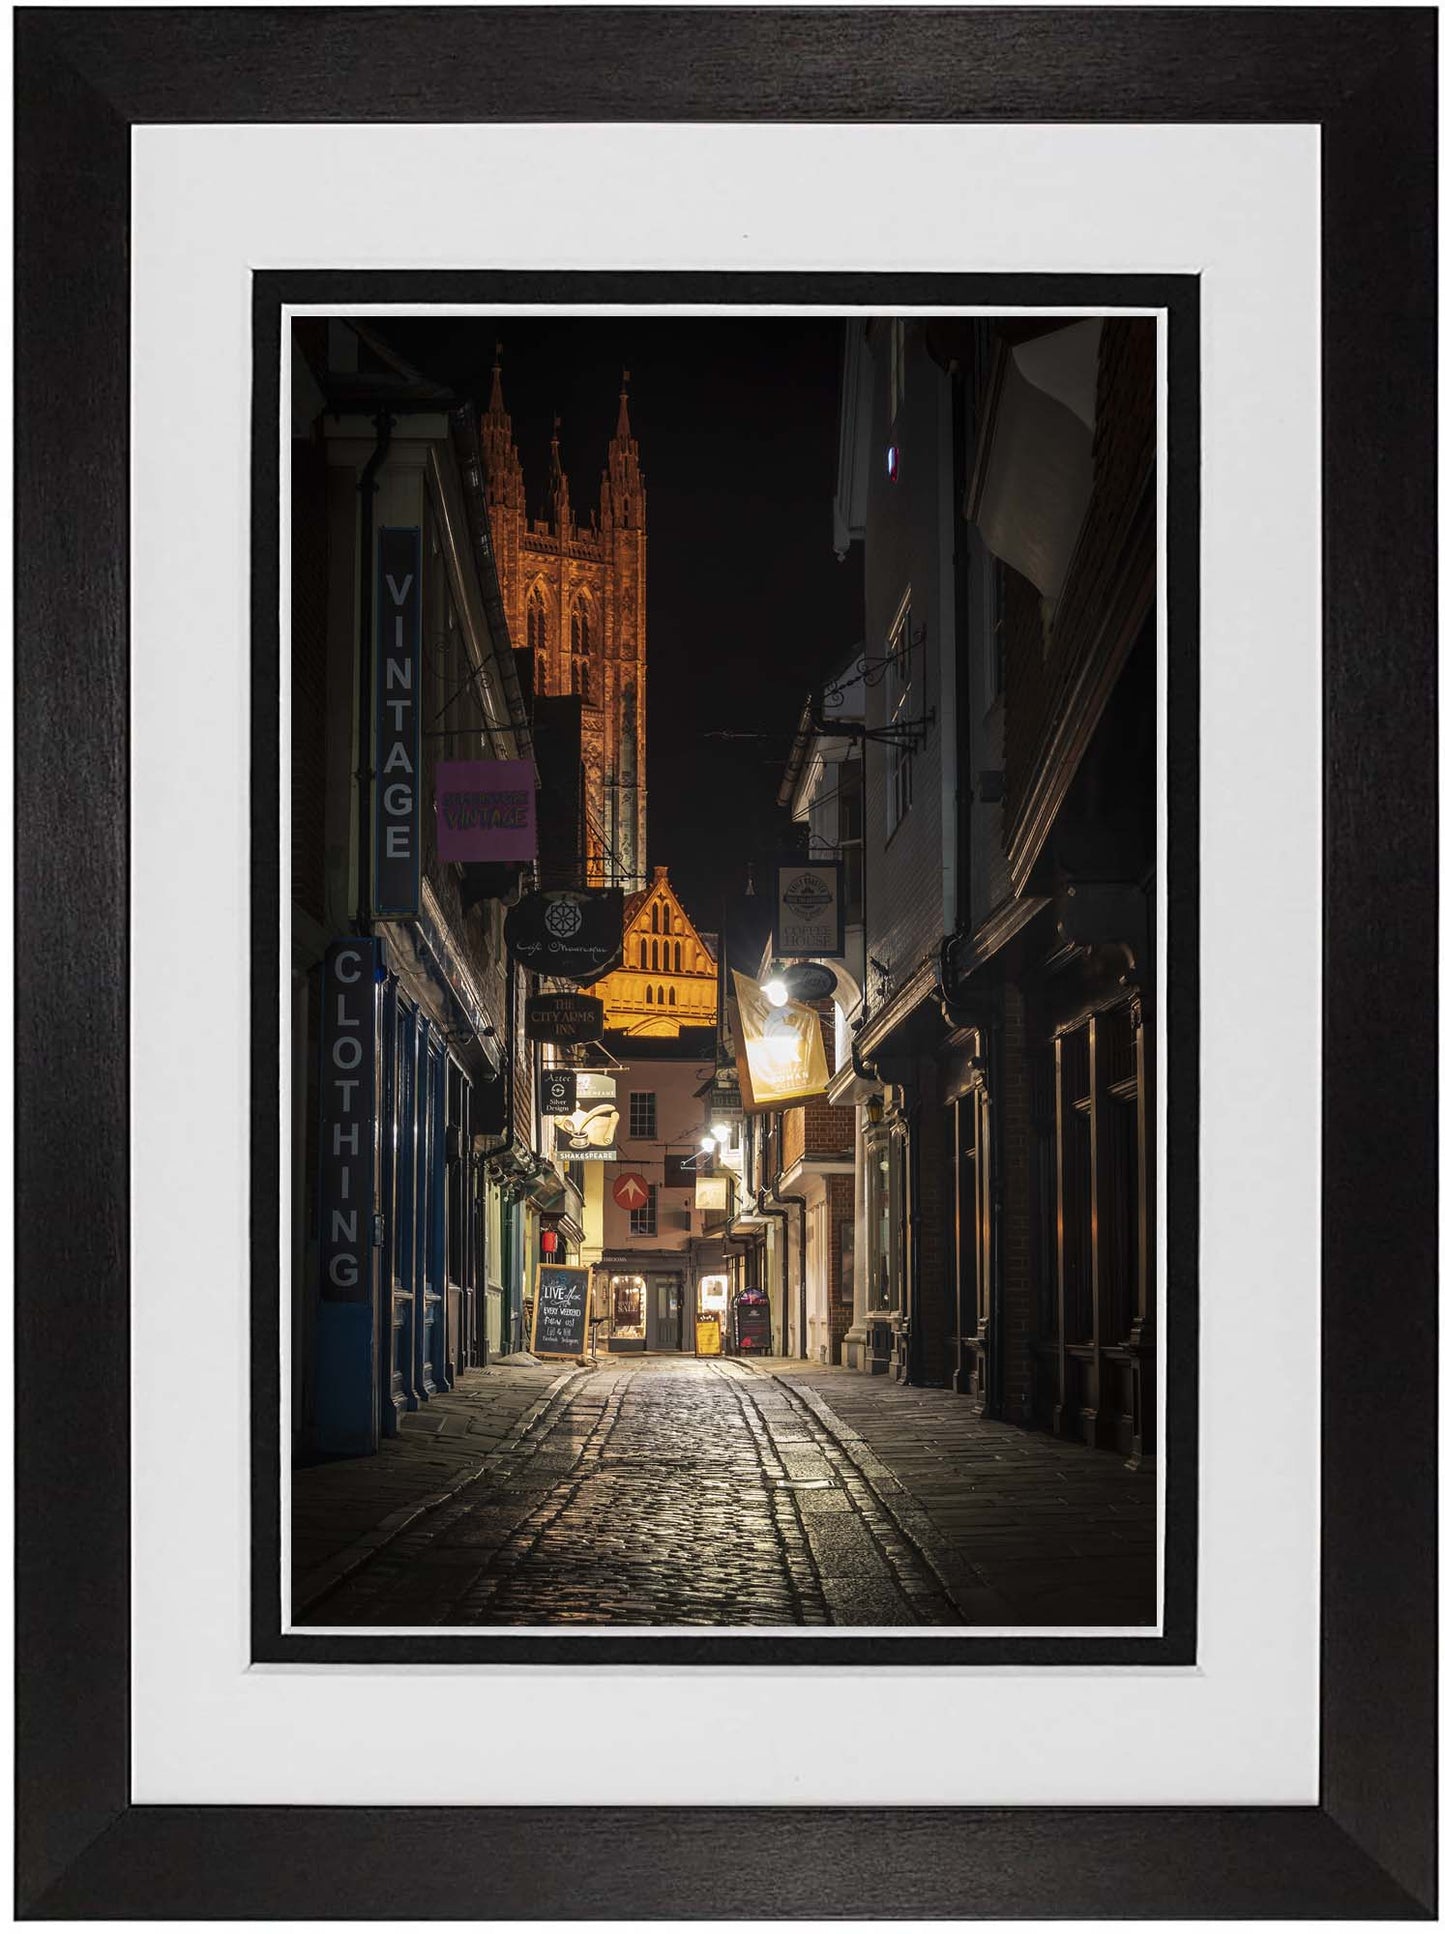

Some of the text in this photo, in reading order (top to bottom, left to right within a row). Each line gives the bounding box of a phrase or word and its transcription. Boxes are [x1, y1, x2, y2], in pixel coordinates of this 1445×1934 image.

[384, 574, 413, 858] VINTAGE
[554, 999, 575, 1010] THE
[531, 1011, 596, 1023] CITY ARMS
[554, 1024, 577, 1035] INN
[545, 1073, 571, 1082] Aztec
[546, 1105, 570, 1113] Designs
[330, 951, 363, 1288] CLOTHING
[560, 1152, 613, 1160] SHAKESPEARE
[544, 1286, 565, 1300] LIVE
